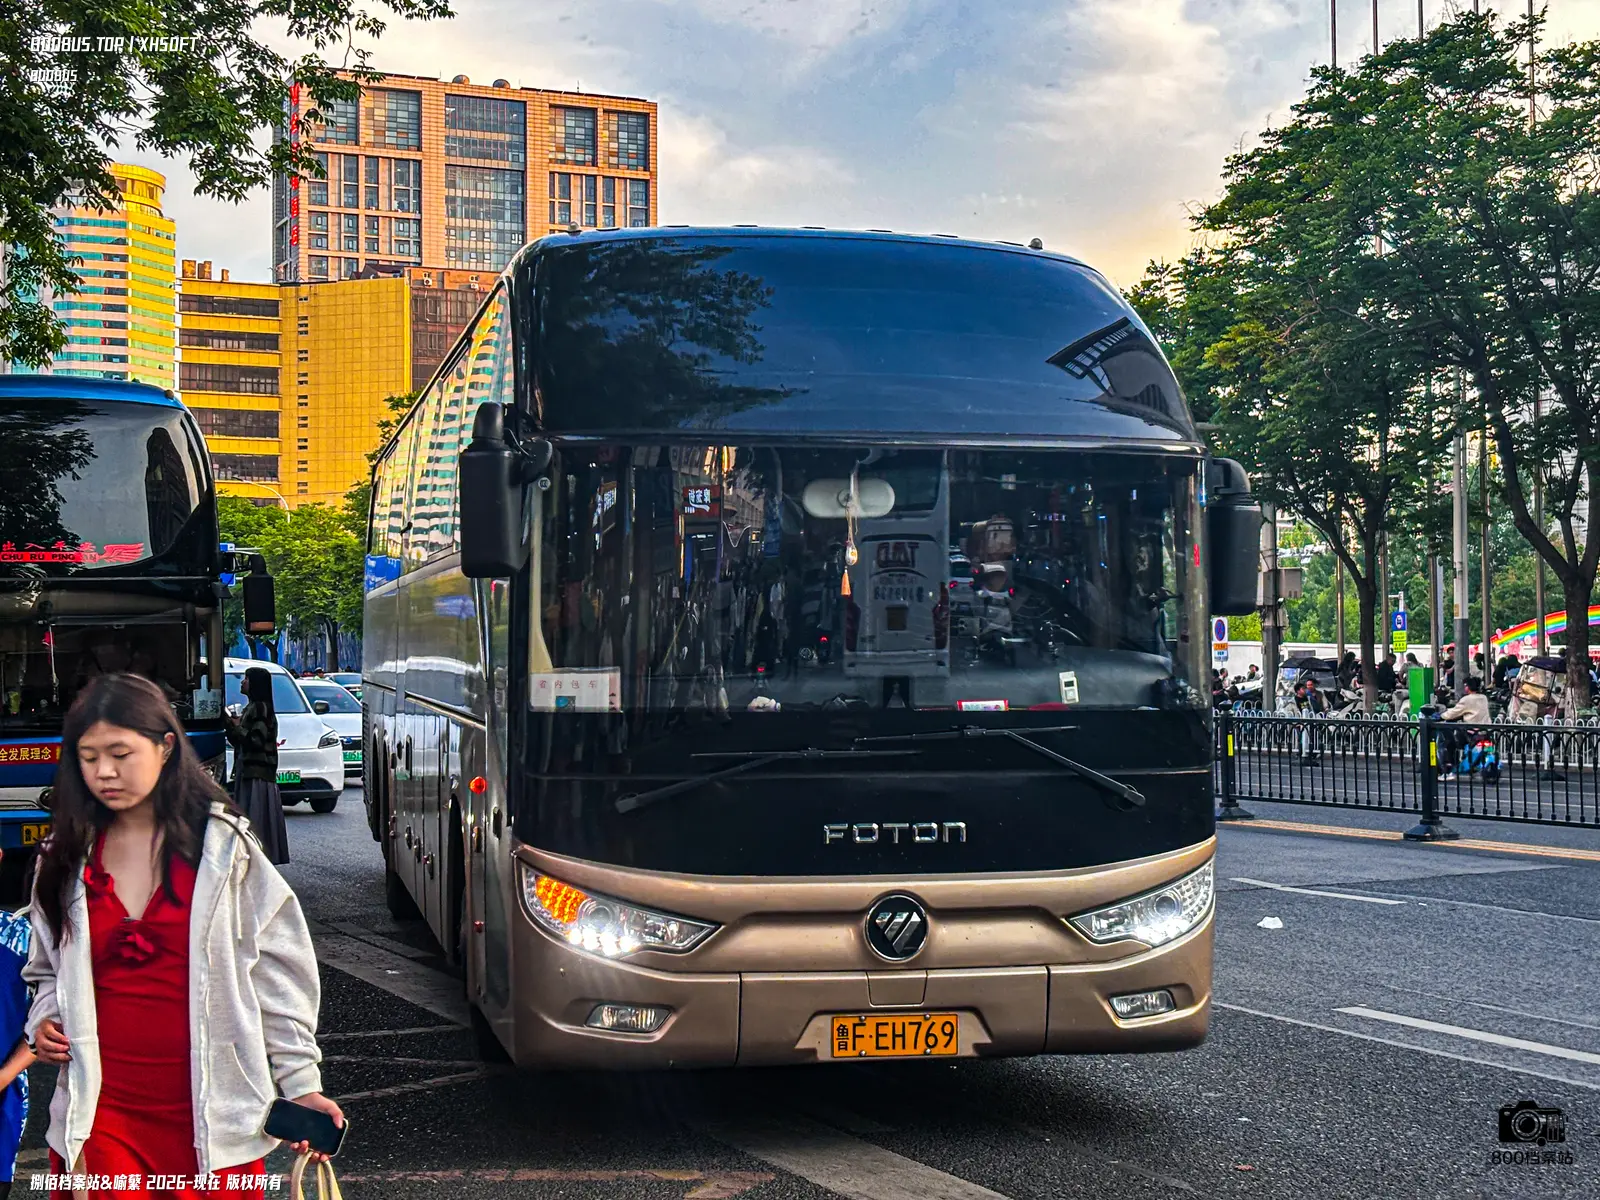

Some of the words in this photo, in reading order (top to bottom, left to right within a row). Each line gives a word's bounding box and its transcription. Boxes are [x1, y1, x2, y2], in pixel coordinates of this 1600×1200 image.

[51, 553, 76, 561] PING
[538, 679, 597, 689] 省内包车
[0, 746, 52, 761] 全发展理念
[823, 821, 967, 845] FOTON
